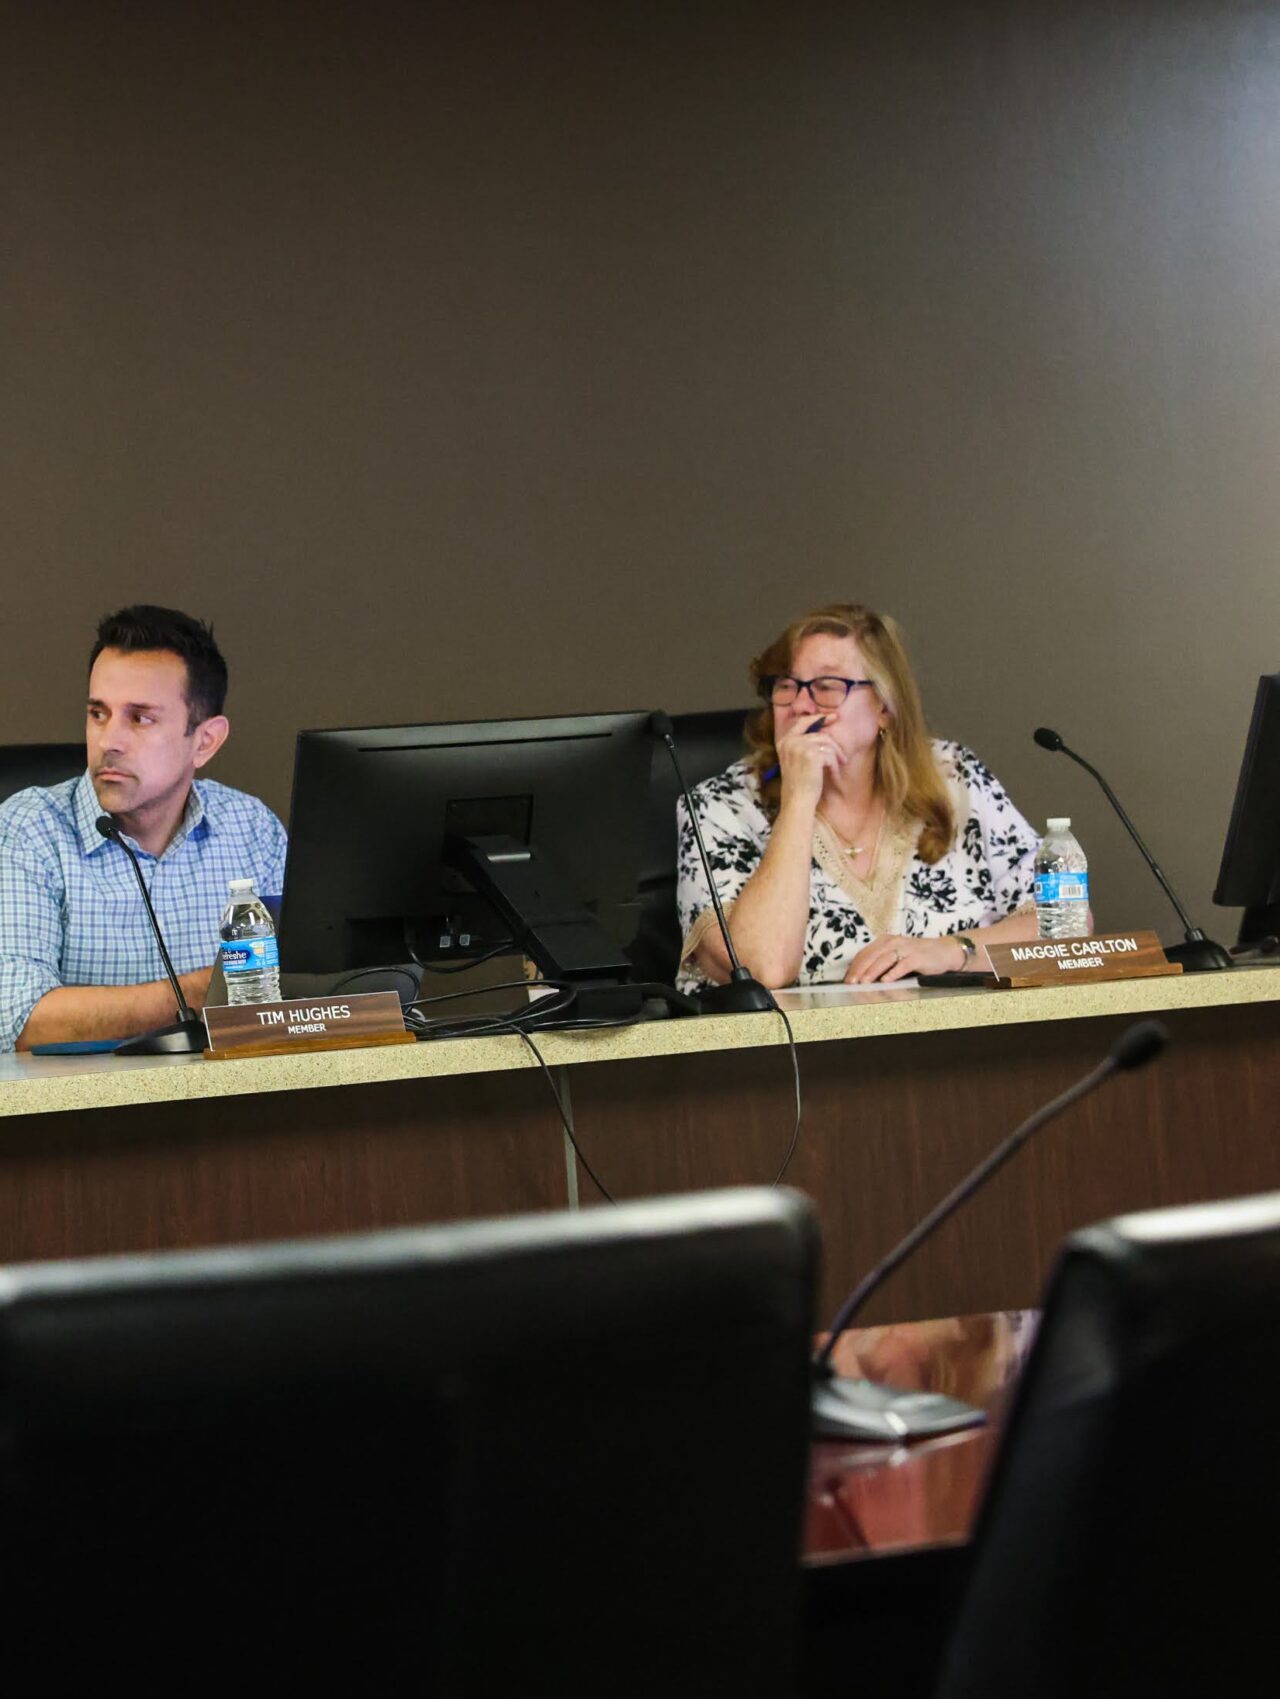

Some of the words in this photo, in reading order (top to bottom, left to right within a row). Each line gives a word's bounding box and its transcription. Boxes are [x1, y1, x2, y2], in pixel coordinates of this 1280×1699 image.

[1011, 945, 1070, 961] MAGGIE
[1071, 938, 1138, 955] CARLTON
[1058, 957, 1104, 969] MEMBER
[257, 1010, 285, 1025] TIM
[290, 1005, 351, 1023] HUGHES
[288, 1023, 326, 1034] MEMBER
